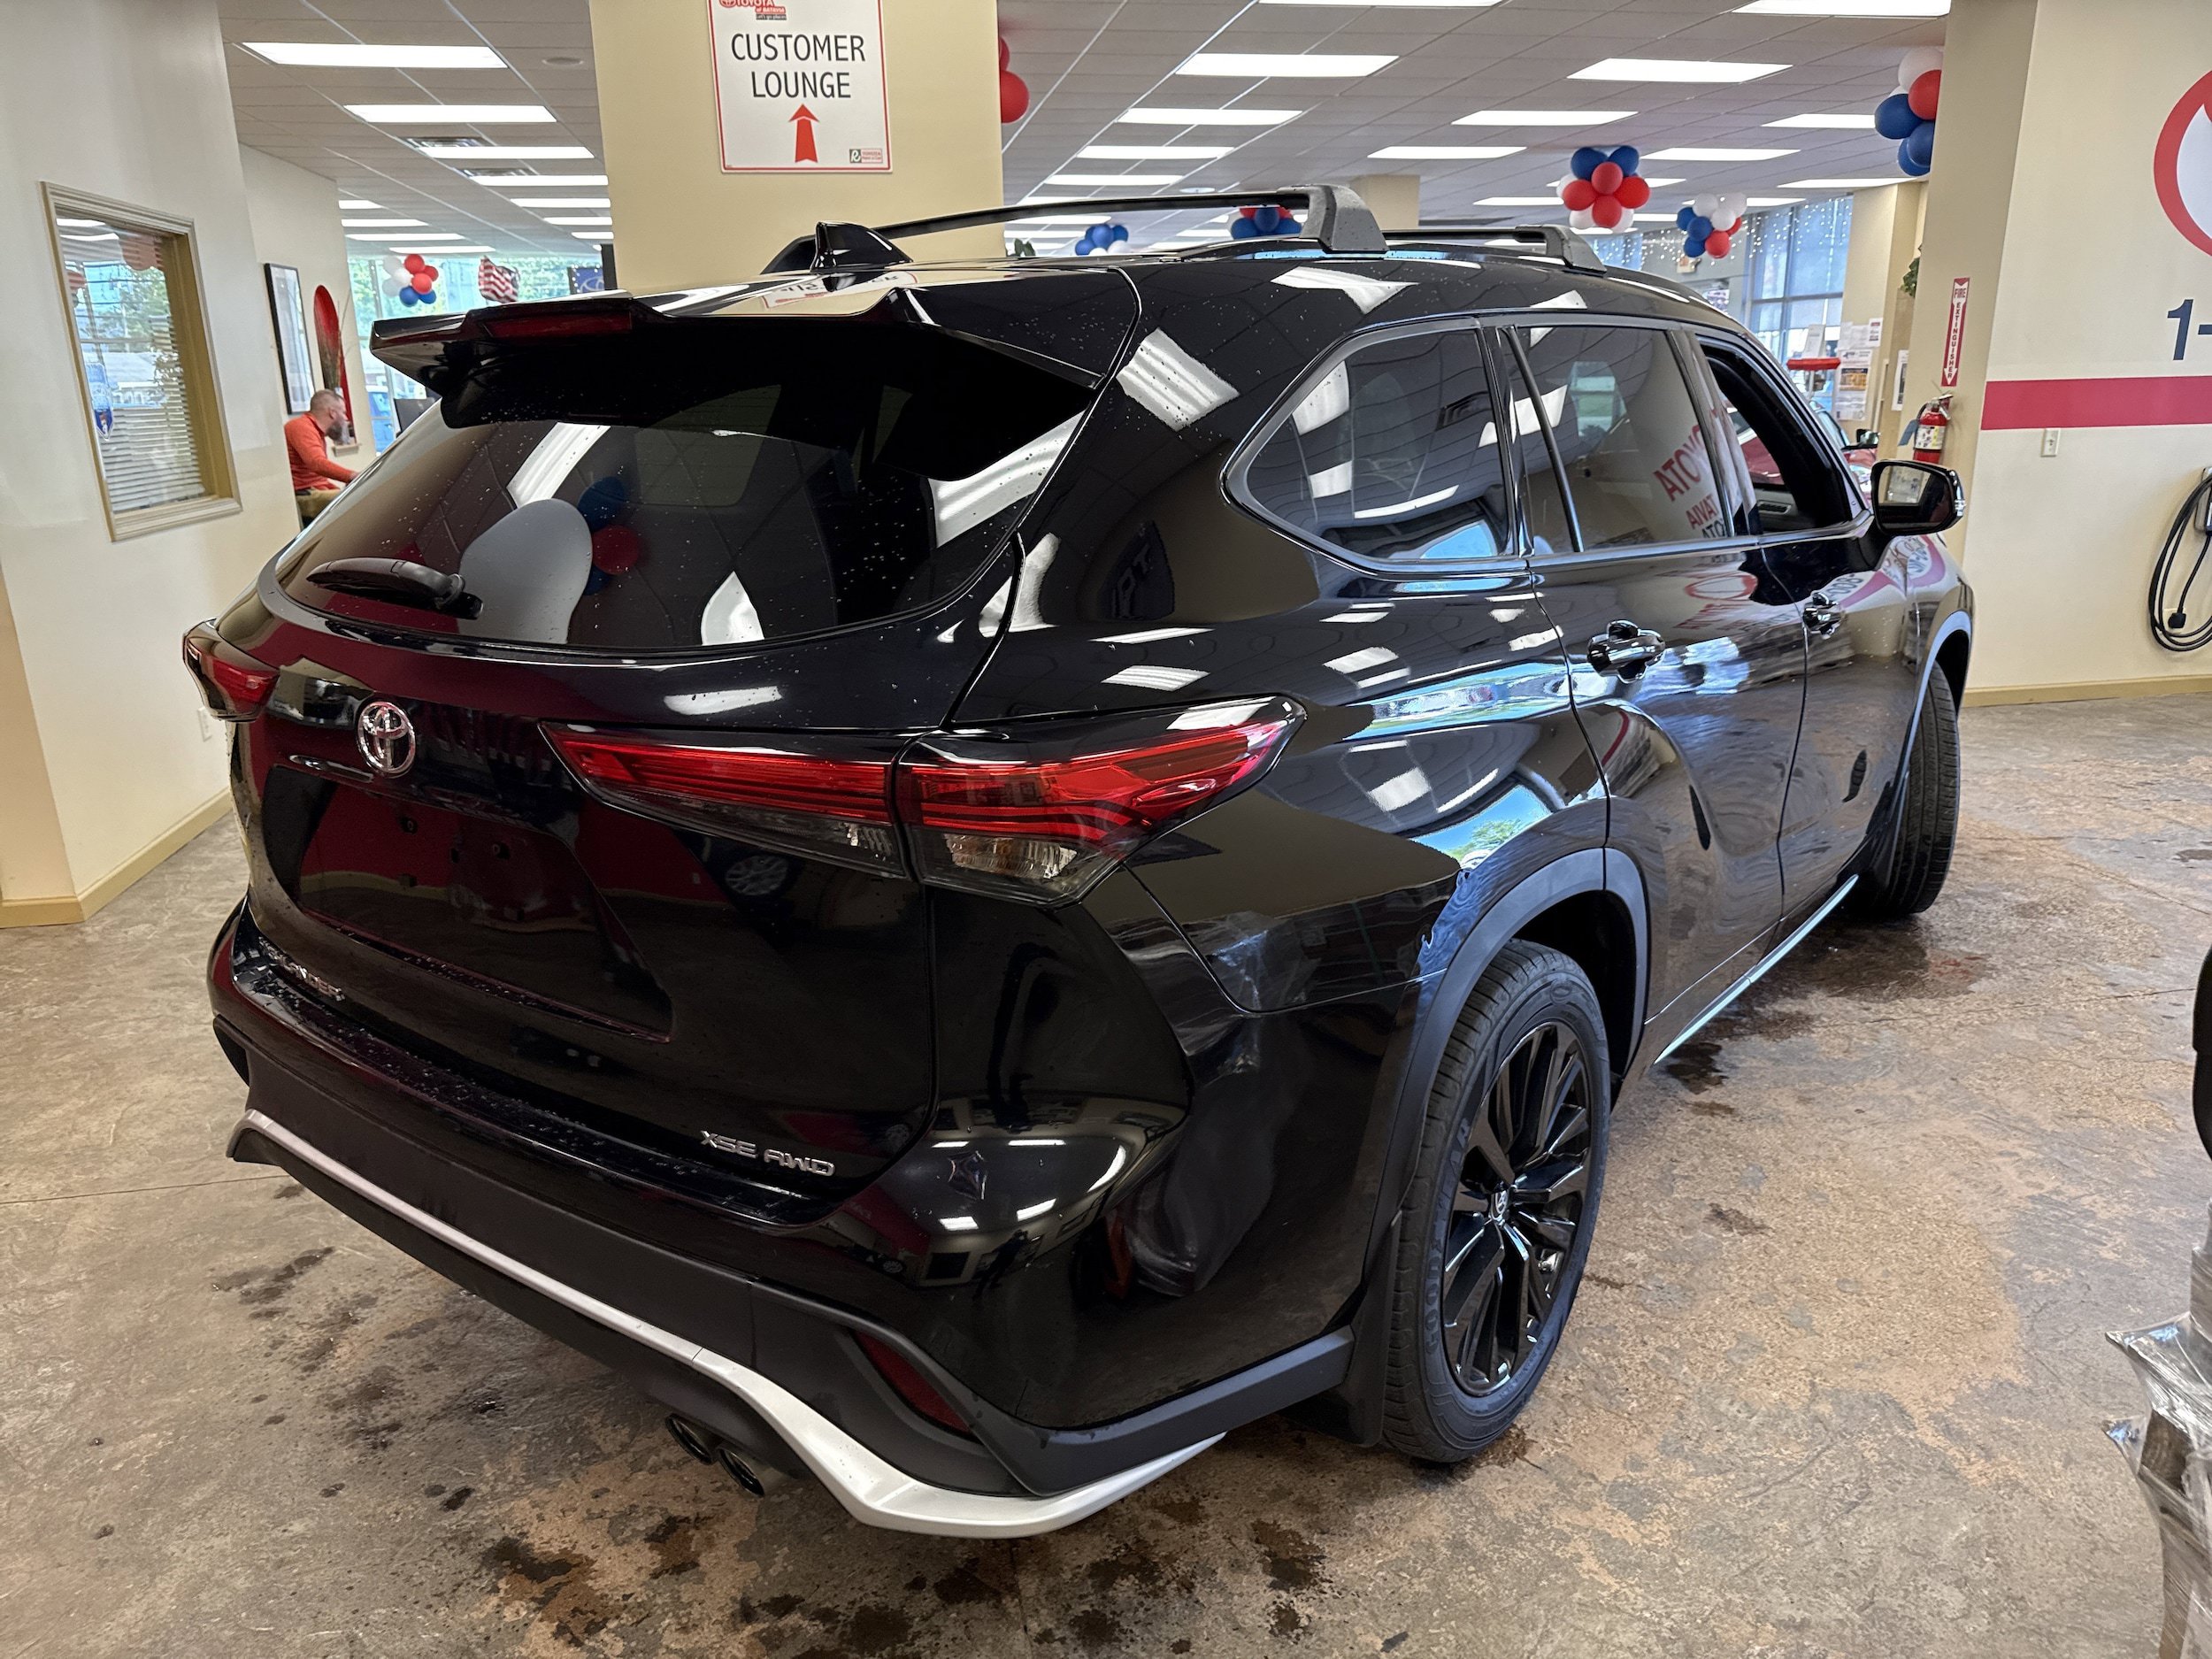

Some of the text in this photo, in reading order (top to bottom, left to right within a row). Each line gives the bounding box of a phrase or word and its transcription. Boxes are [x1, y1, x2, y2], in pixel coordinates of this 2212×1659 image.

[731, 33, 866, 62] CUSTOMER
[751, 71, 851, 98] LOUNGE
[1954, 288, 1967, 299] FIRE
[1947, 302, 1962, 379] EXTINGUISHER
[701, 1130, 835, 1177] XSE AWD
